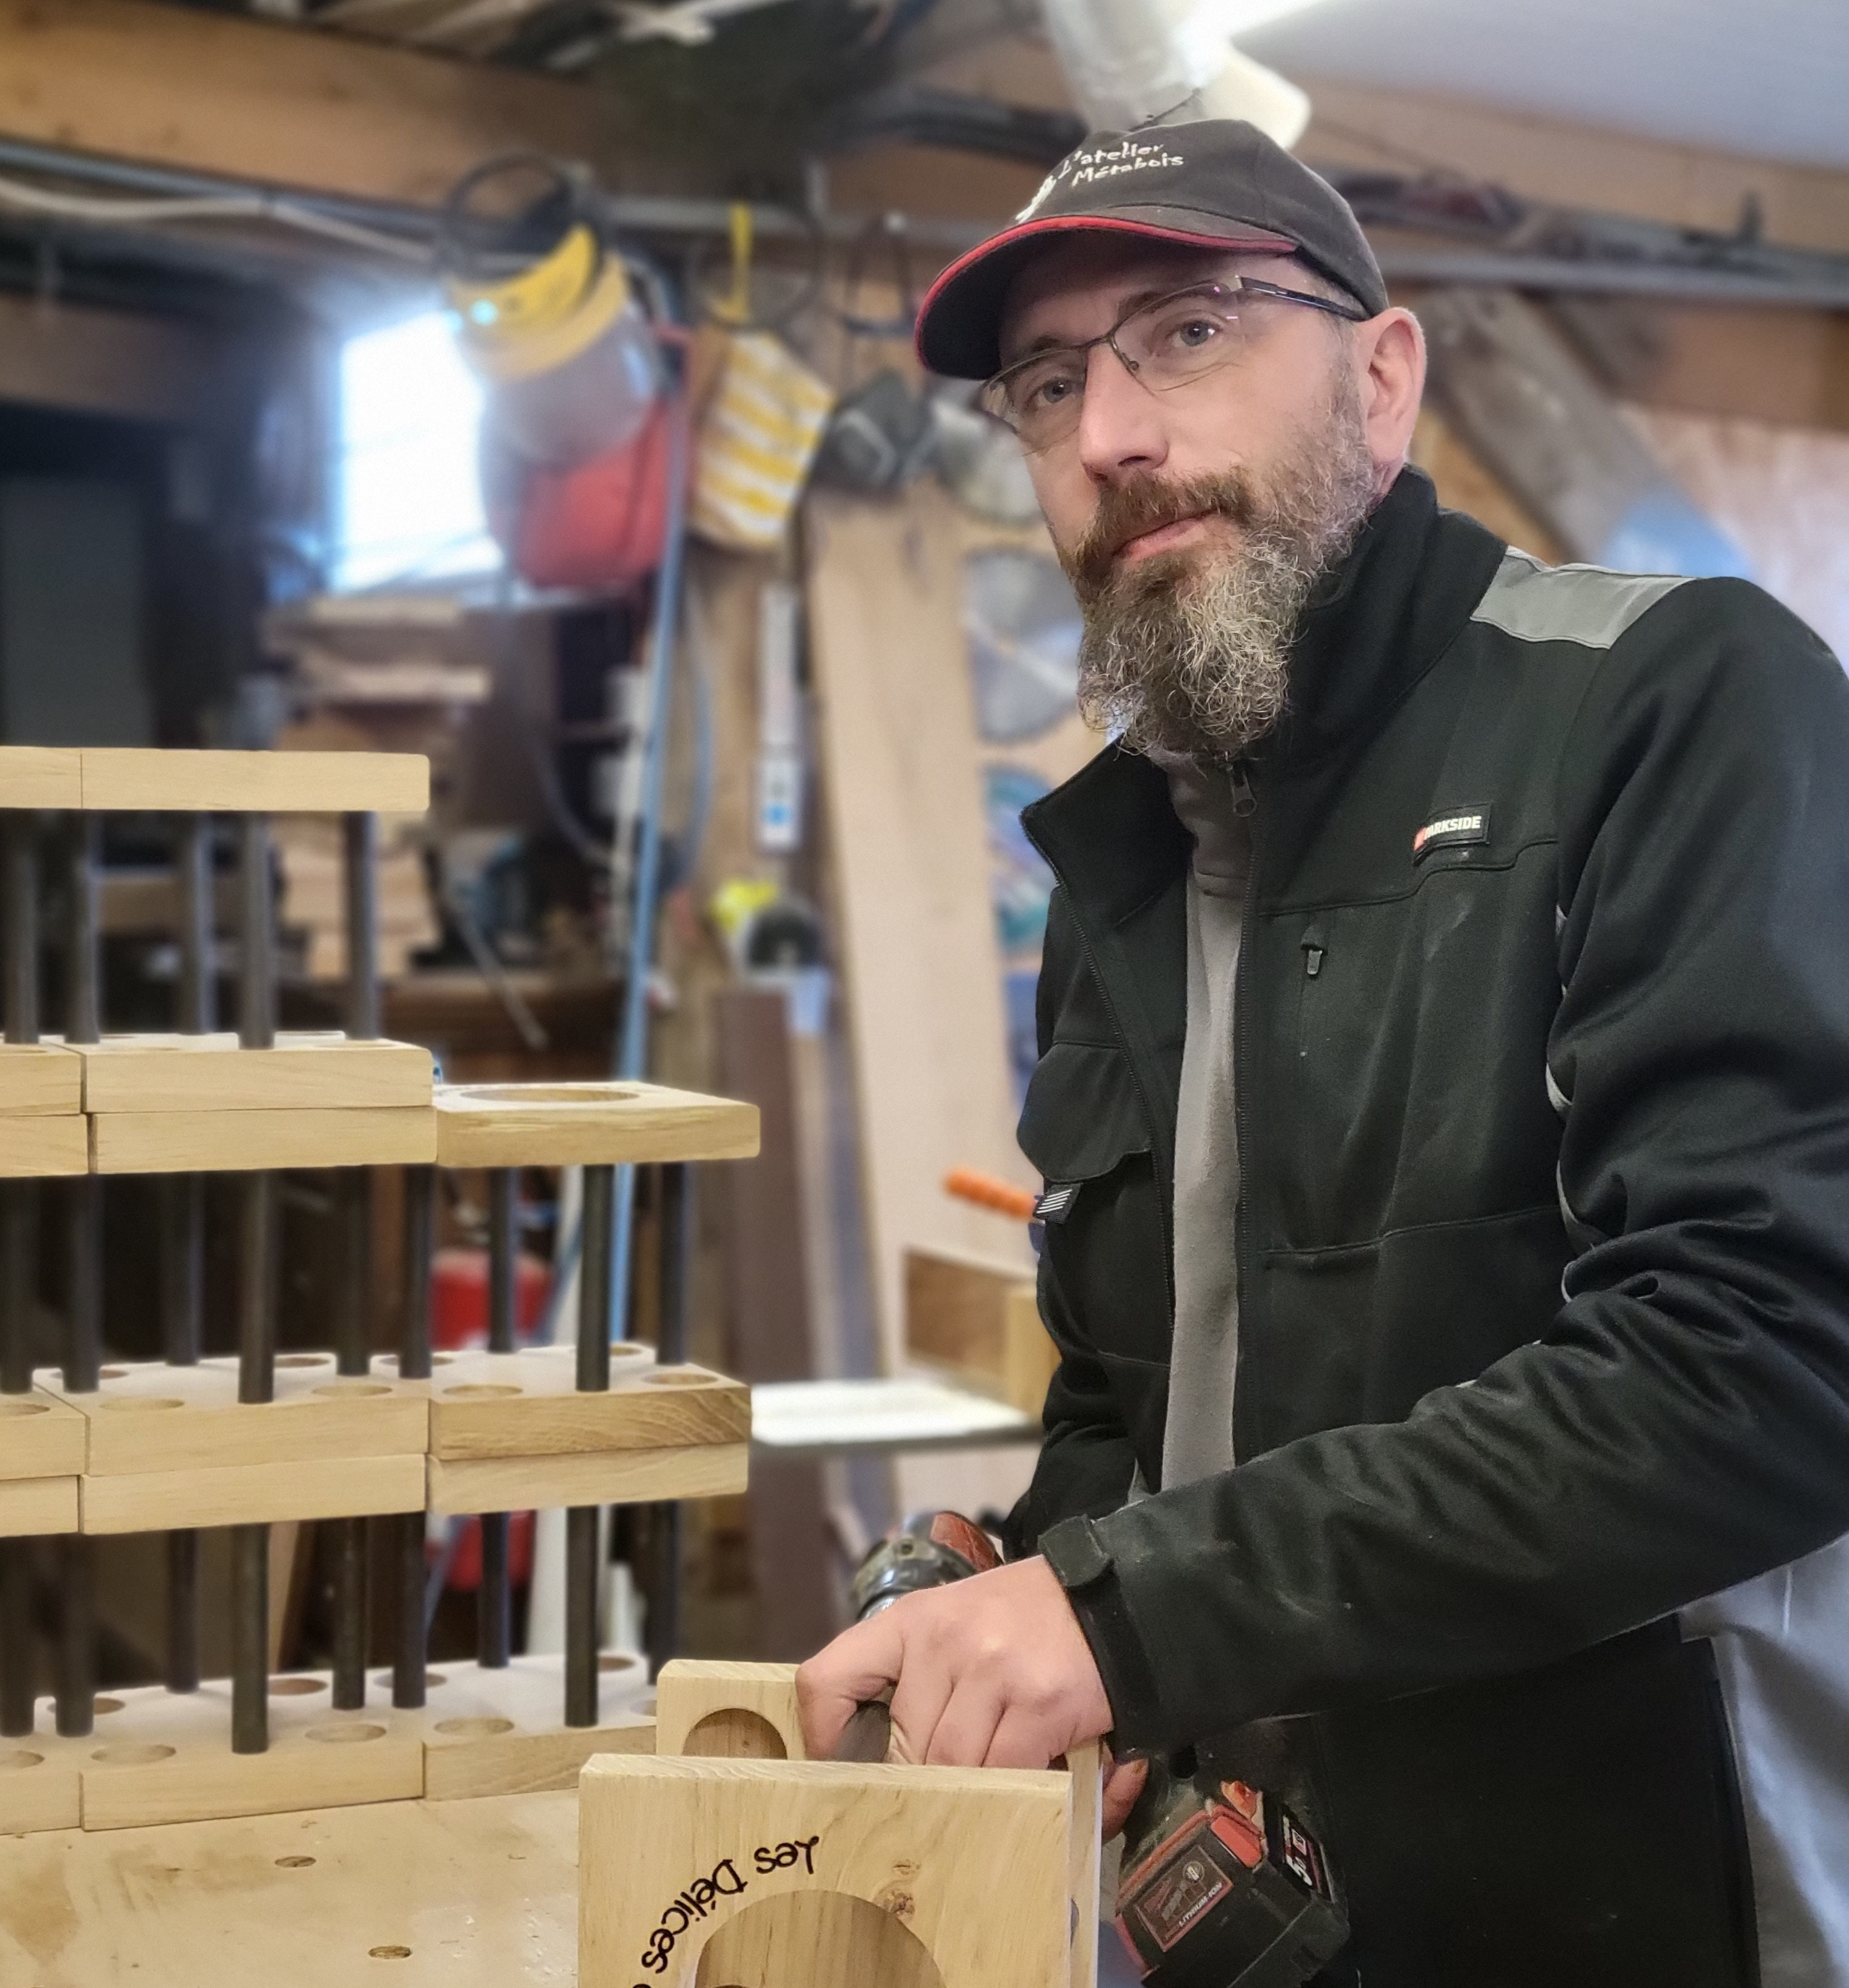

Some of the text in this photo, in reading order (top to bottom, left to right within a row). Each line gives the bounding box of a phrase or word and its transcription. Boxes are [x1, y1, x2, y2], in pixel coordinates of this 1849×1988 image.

[1058, 141, 1164, 180] L'atelier
[1071, 152, 1184, 186] Métabois
[641, 1835, 820, 1974] Les Délices
